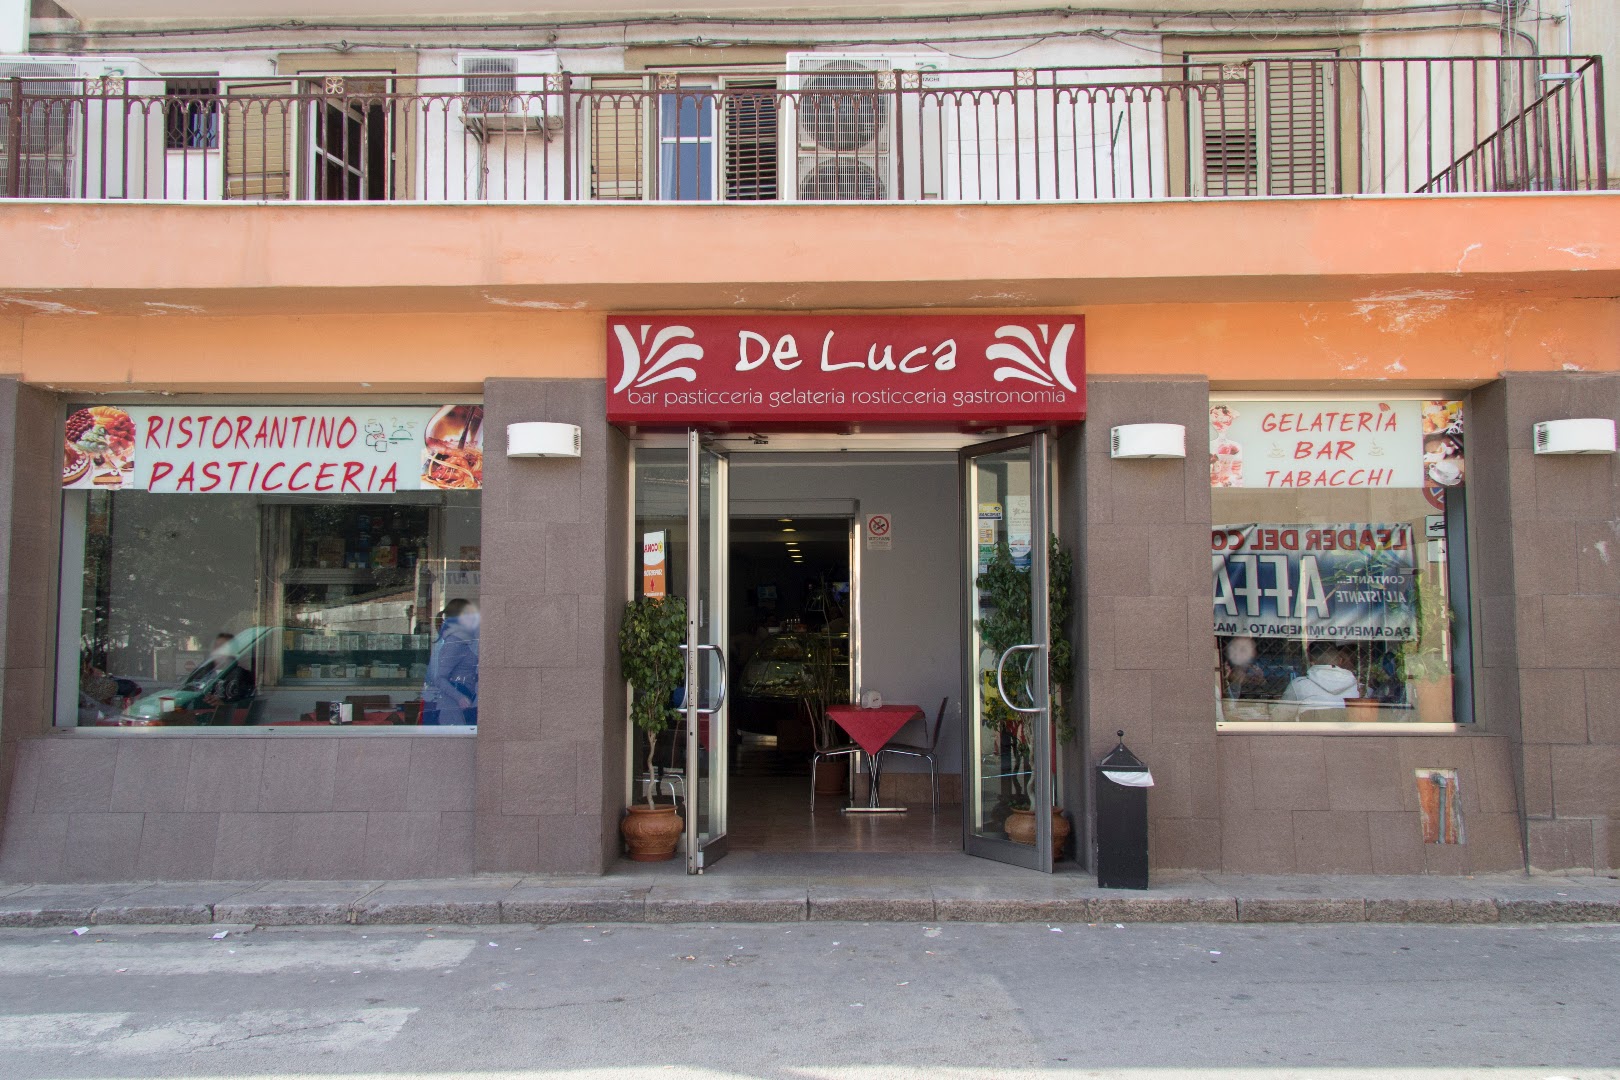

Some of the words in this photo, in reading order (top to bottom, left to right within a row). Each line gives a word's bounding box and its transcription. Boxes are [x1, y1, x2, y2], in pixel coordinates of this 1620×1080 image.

[735, 331, 803, 372] De
[820, 329, 957, 374] Luca
[628, 388, 659, 405] bar
[664, 387, 763, 408] pasticceria
[768, 387, 845, 408] gelateria
[852, 387, 947, 405] rosticceria
[952, 387, 1066, 408] gastronomia
[145, 415, 357, 450] RISTORANTINO
[1261, 411, 1397, 433] GELATERIA
[1293, 440, 1356, 461] BAR
[148, 461, 398, 493] PASTICCERIA
[1265, 468, 1393, 488] TABACCHI
